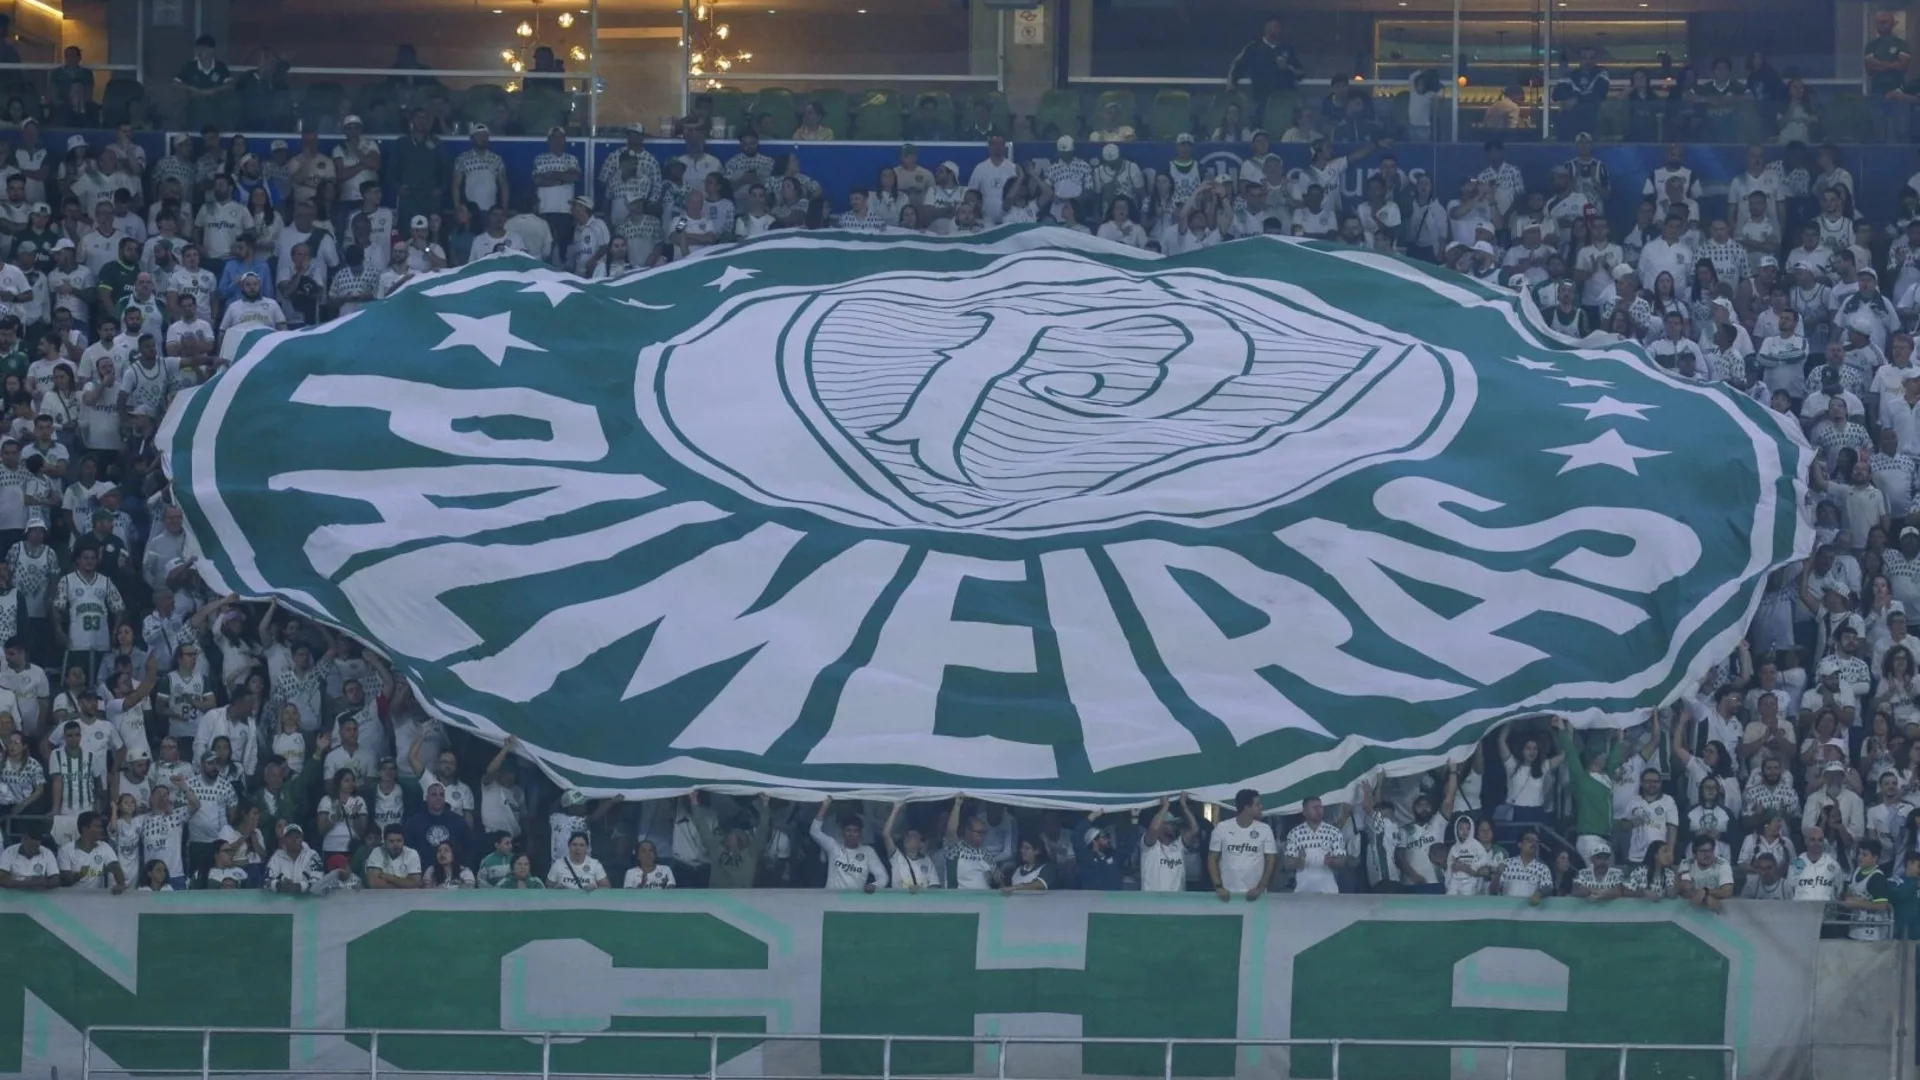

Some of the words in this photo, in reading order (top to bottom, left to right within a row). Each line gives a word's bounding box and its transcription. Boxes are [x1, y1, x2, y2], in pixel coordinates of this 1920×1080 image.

[268, 373, 1702, 780] PALMEIRAS
[1227, 842, 1258, 854] crefisa
[1406, 836, 1437, 849] crefisa
[834, 859, 863, 873] crefisa
[1798, 876, 1833, 888] crefisa
